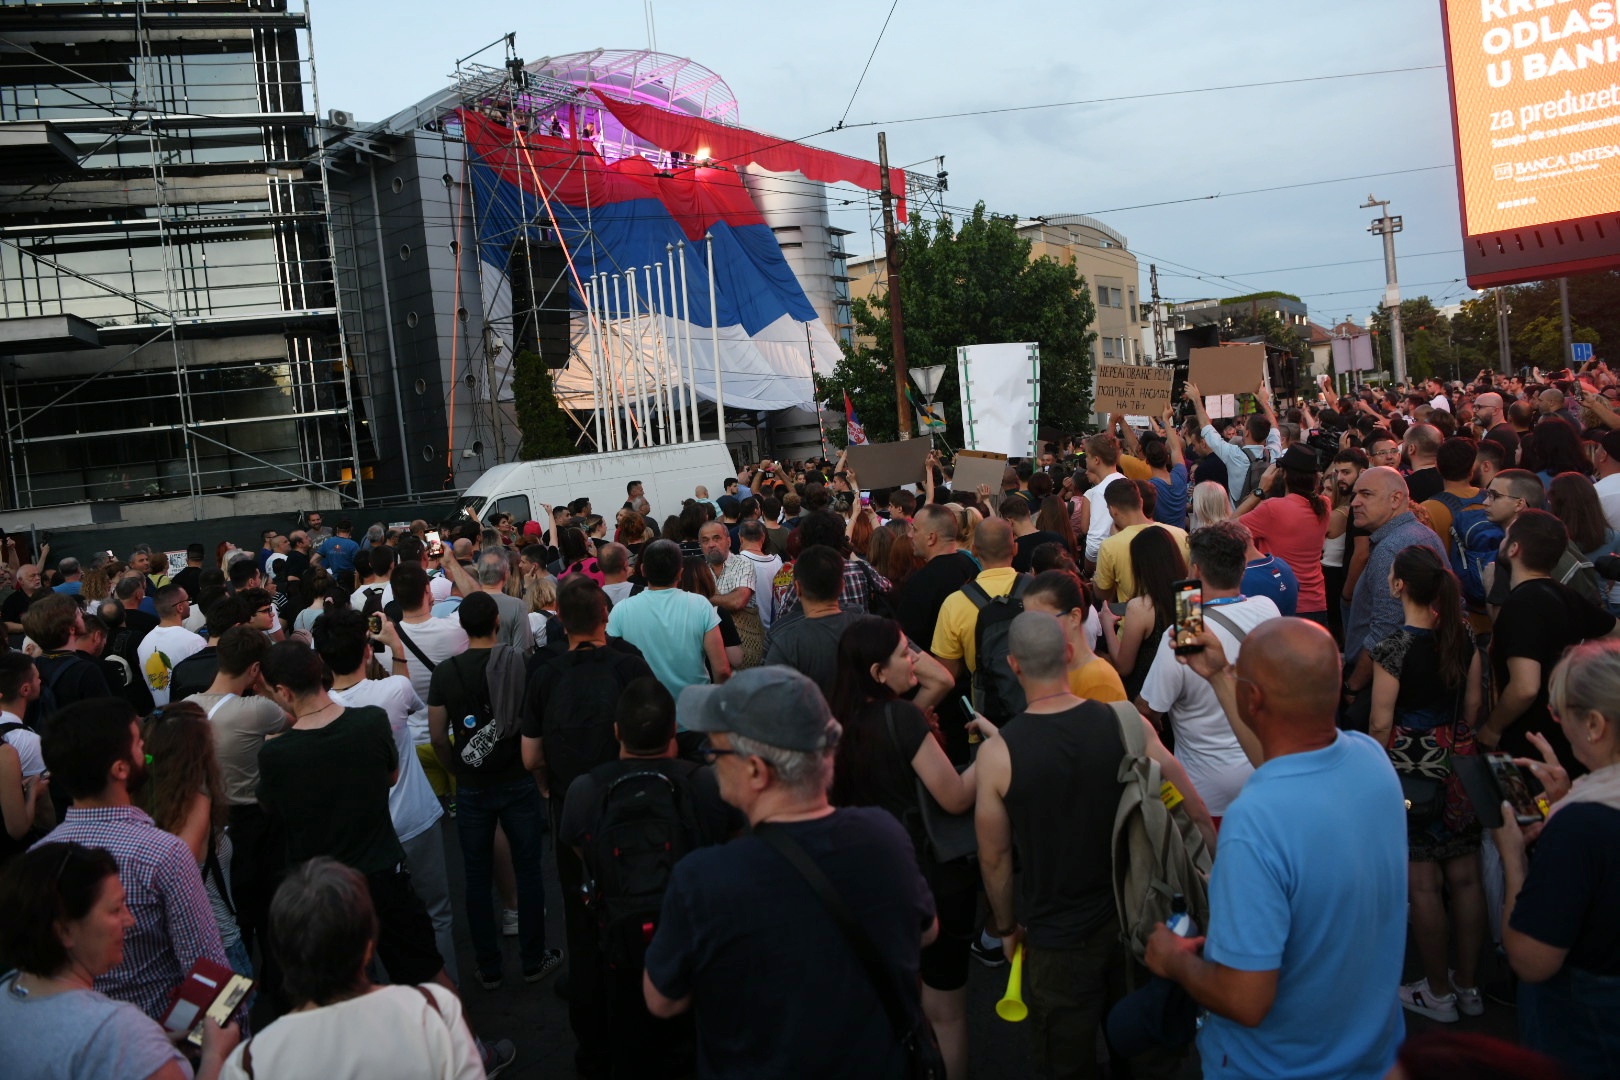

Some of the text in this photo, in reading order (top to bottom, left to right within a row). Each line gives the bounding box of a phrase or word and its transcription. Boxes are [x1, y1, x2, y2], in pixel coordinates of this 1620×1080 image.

[1481, 0, 1572, 22] KR
[1482, 0, 1620, 55] ODLAS
[1487, 60, 1512, 88] U
[1489, 109, 1515, 131] za
[1514, 155, 1567, 175] BANCA
[1569, 144, 1620, 165] INTESA
[1097, 385, 1136, 398] ПОДРШКА
[1116, 400, 1127, 410] НА
[475, 739, 492, 756] THE
